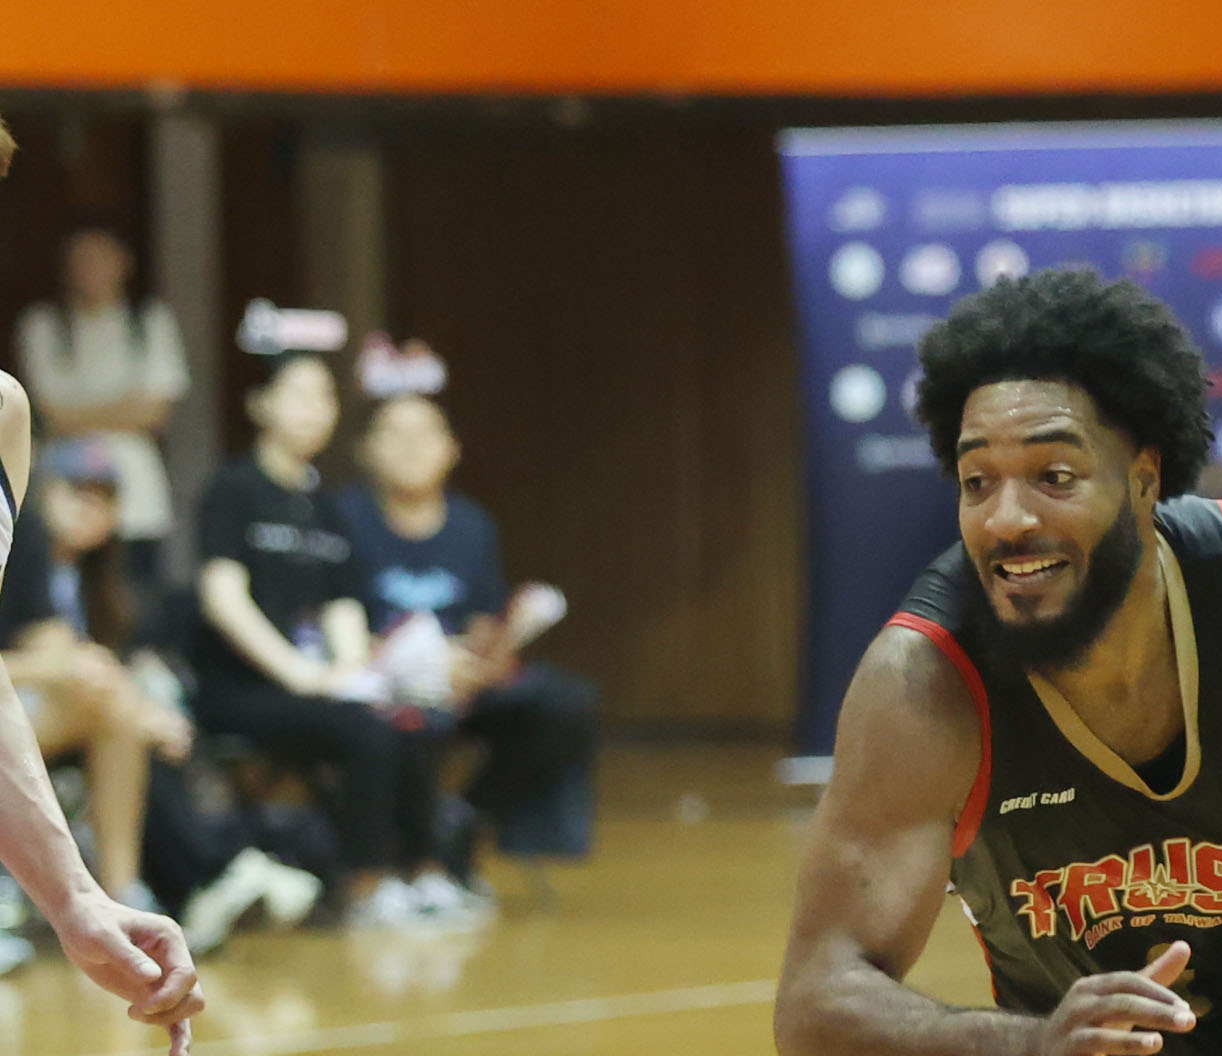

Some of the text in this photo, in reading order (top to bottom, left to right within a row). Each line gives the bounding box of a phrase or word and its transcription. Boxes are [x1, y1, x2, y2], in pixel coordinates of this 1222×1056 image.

[999, 787, 1076, 815] CREDIT CARD
[1084, 916, 1124, 951] BANK
[1130, 914, 1156, 928] OF
